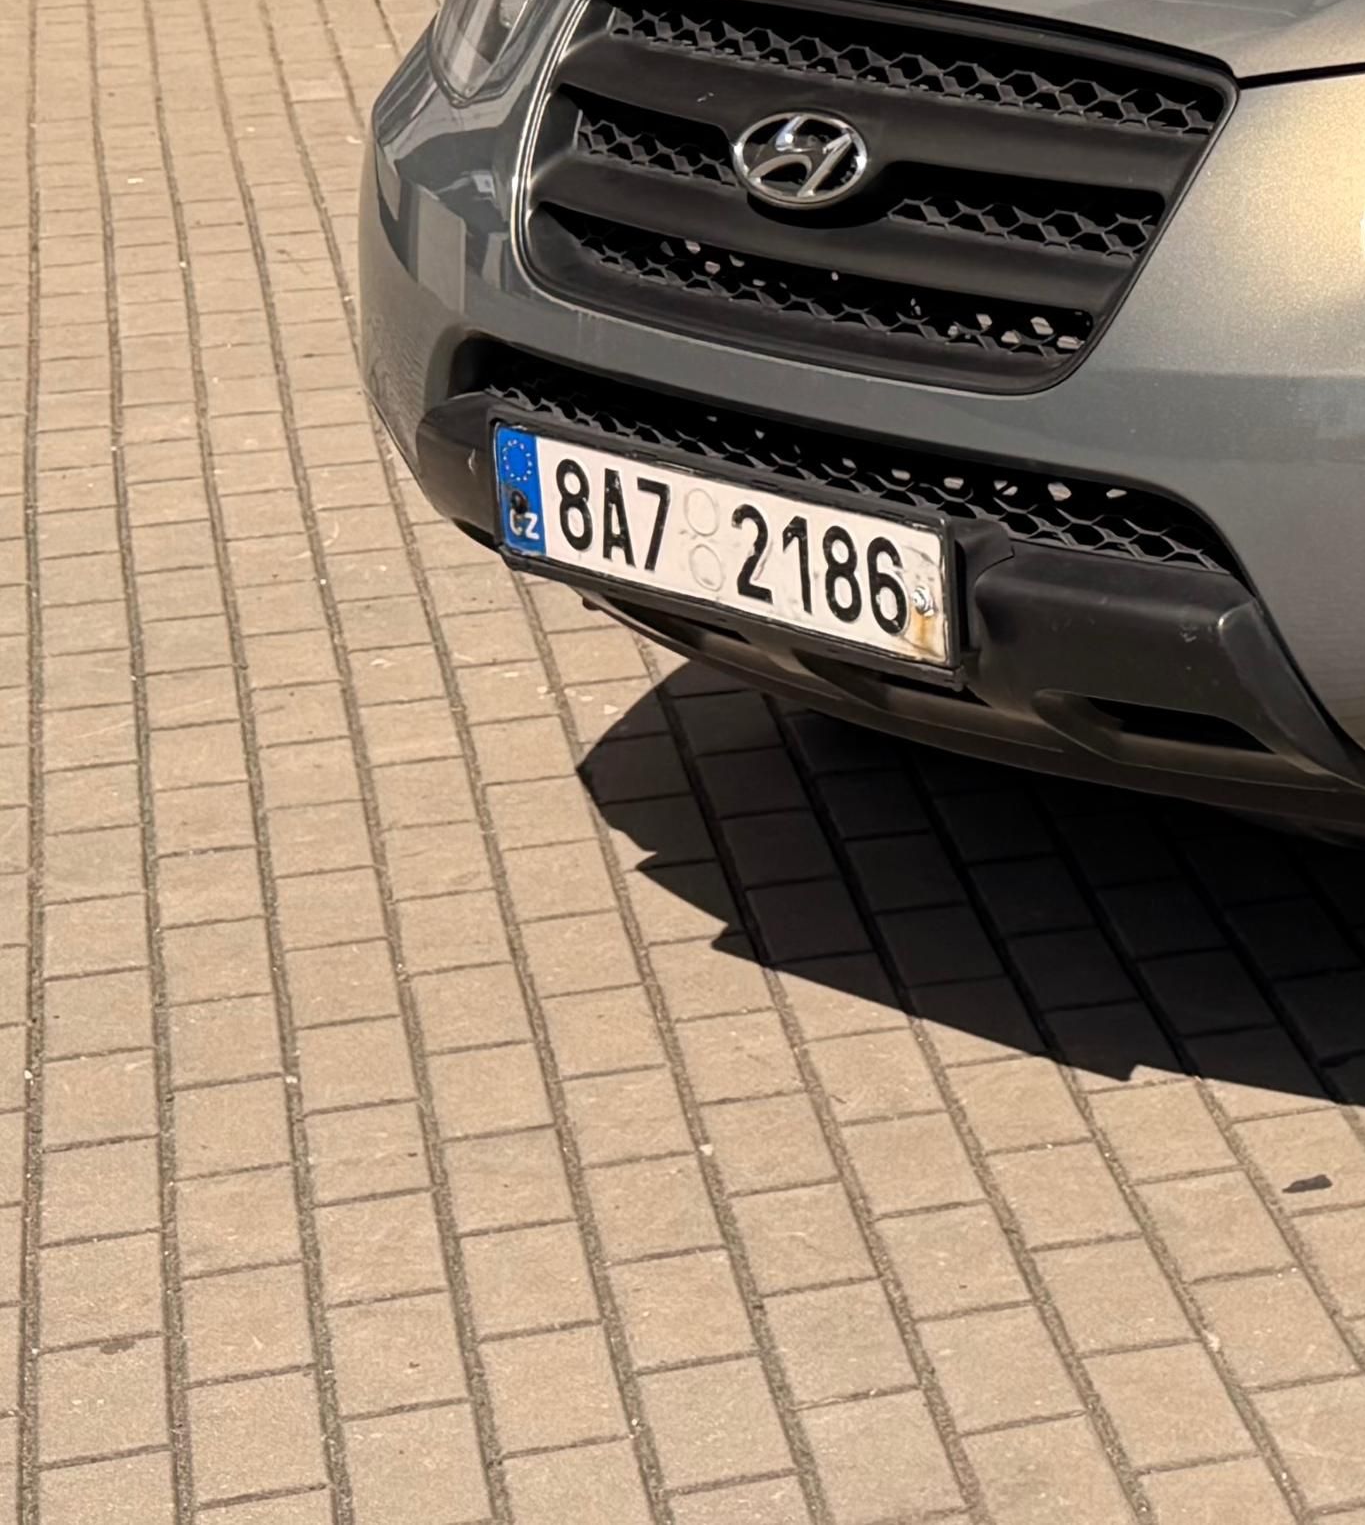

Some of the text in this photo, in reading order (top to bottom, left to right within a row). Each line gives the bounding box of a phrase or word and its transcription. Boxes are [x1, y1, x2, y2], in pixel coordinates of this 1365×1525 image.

[509, 508, 541, 540] CZ
[555, 458, 909, 635] 8A7 2186
